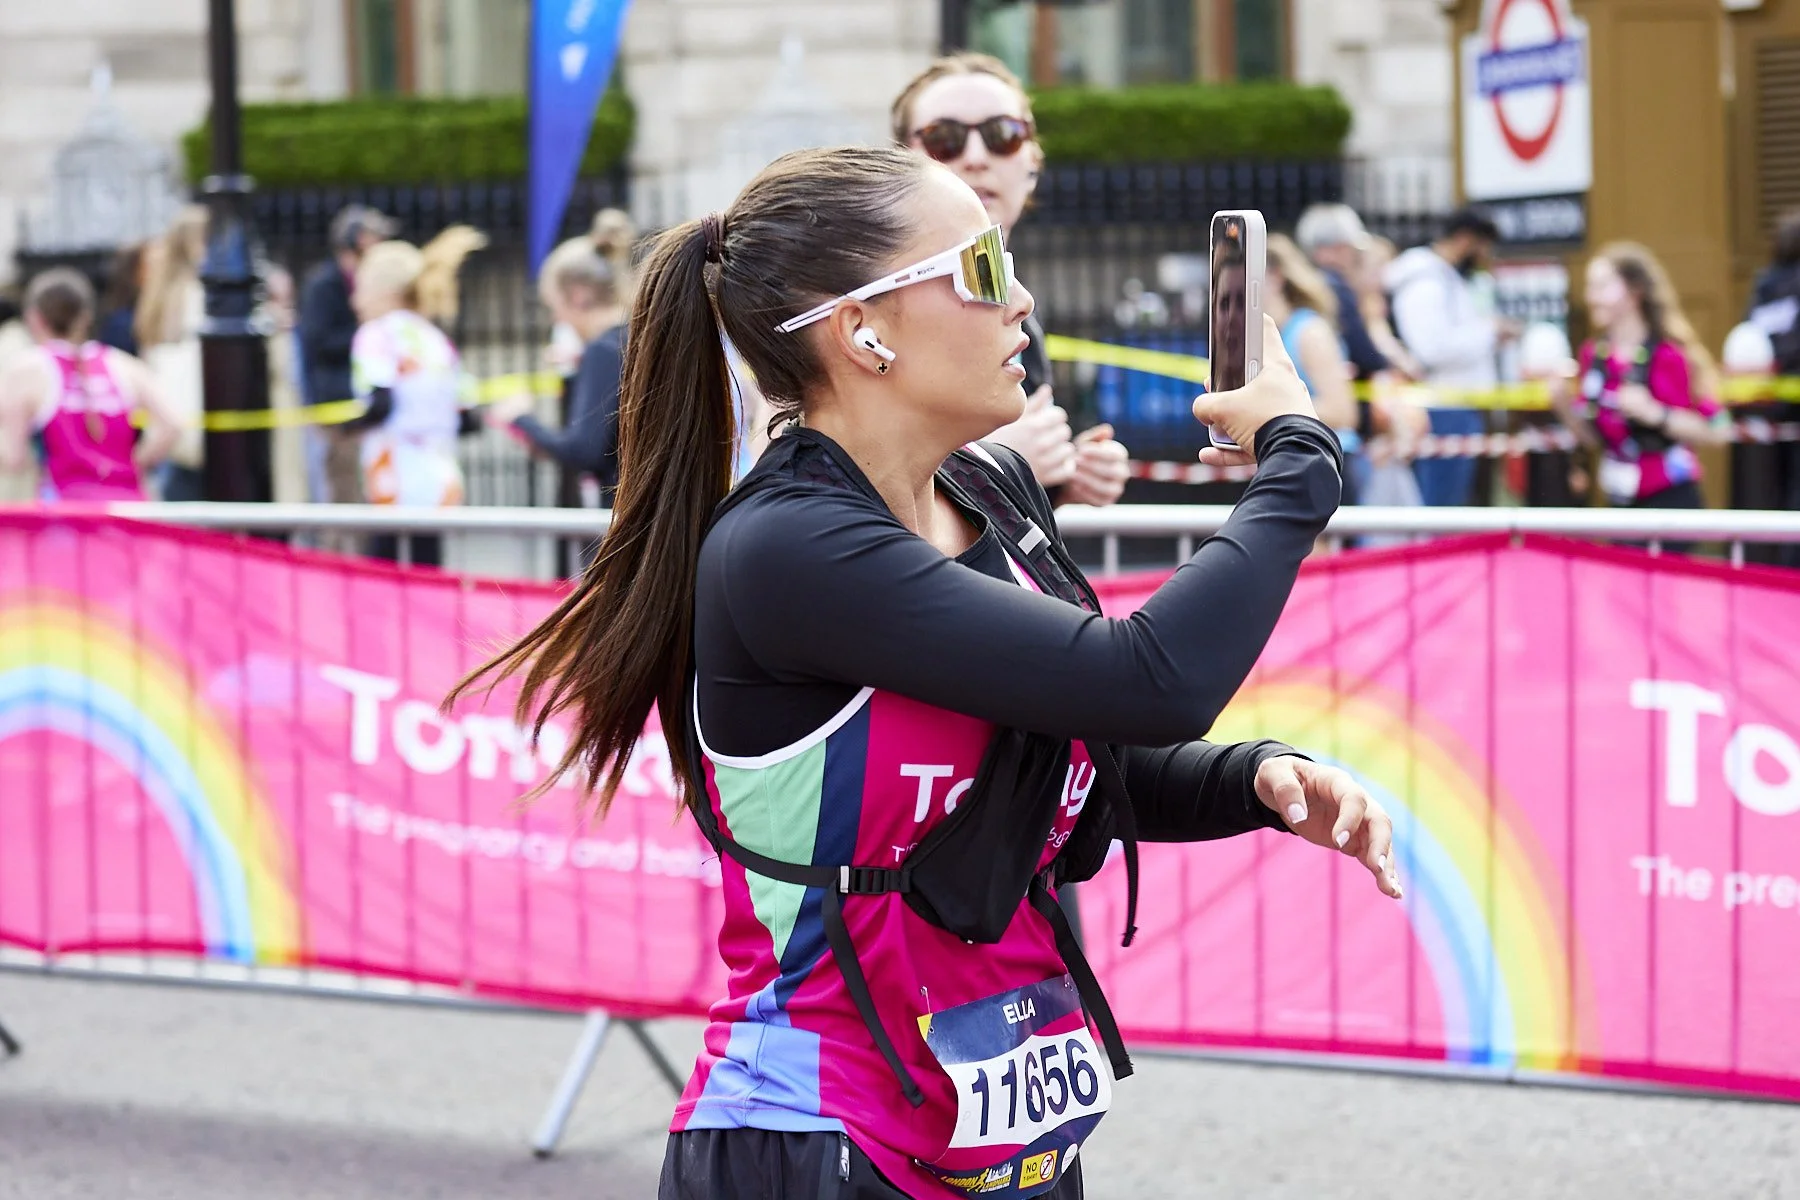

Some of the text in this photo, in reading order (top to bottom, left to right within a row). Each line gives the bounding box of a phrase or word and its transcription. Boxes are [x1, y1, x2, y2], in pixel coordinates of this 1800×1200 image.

[1629, 854, 1713, 902] The
[1002, 998, 1036, 1024] ELLA
[971, 1038, 1099, 1137] 11656
[1025, 1162, 1038, 1174] NO
[940, 1175, 979, 1188] LONDON
